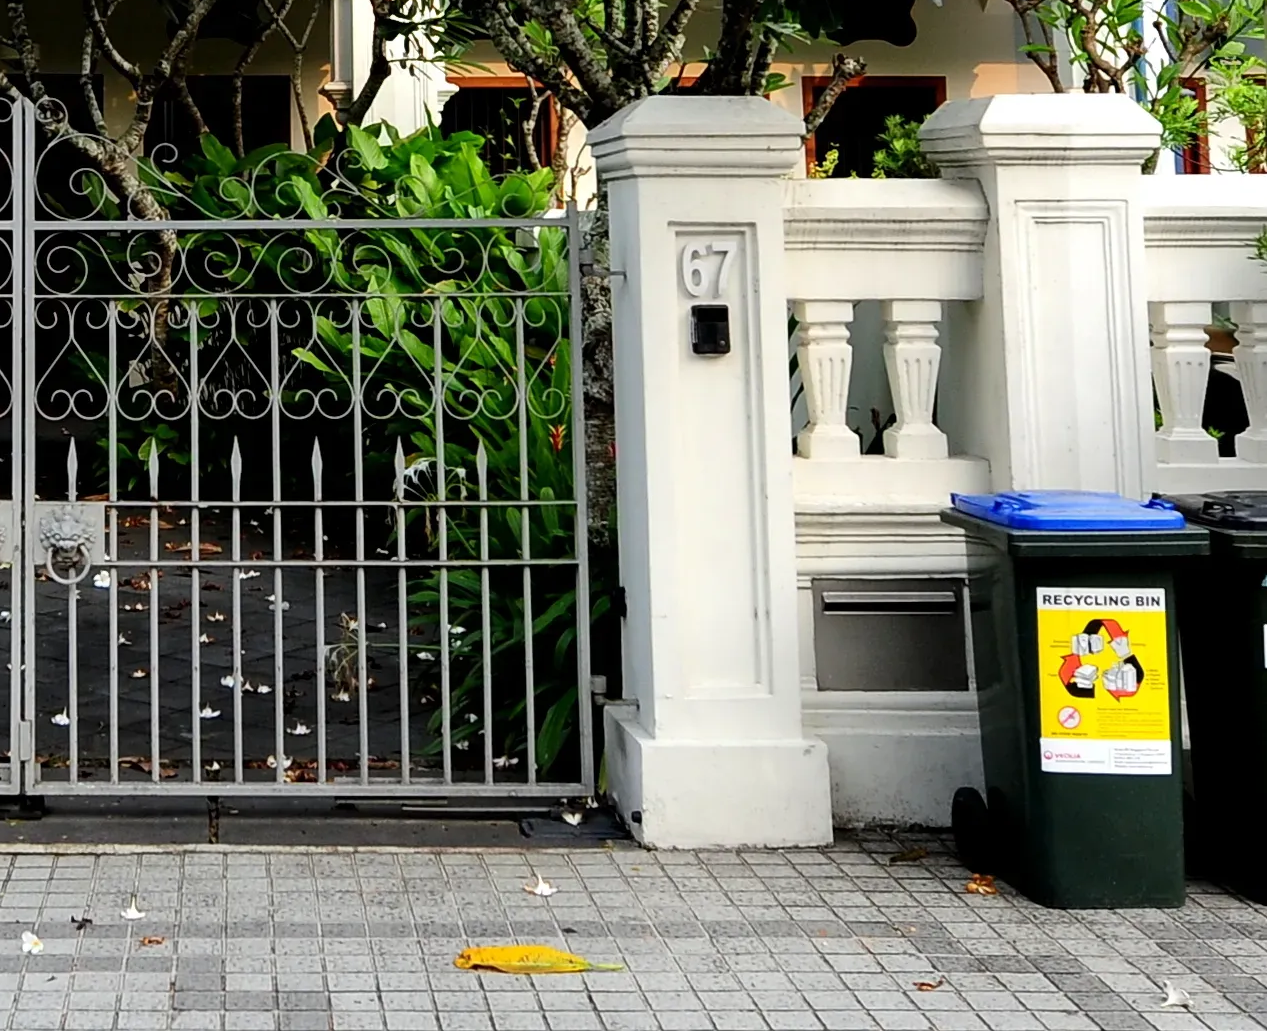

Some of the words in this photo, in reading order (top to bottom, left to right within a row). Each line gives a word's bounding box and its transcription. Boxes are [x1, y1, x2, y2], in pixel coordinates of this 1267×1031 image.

[682, 242, 737, 297] 67
[1042, 594, 1130, 606] RECYCLING
[1135, 595, 1161, 606] BIN
